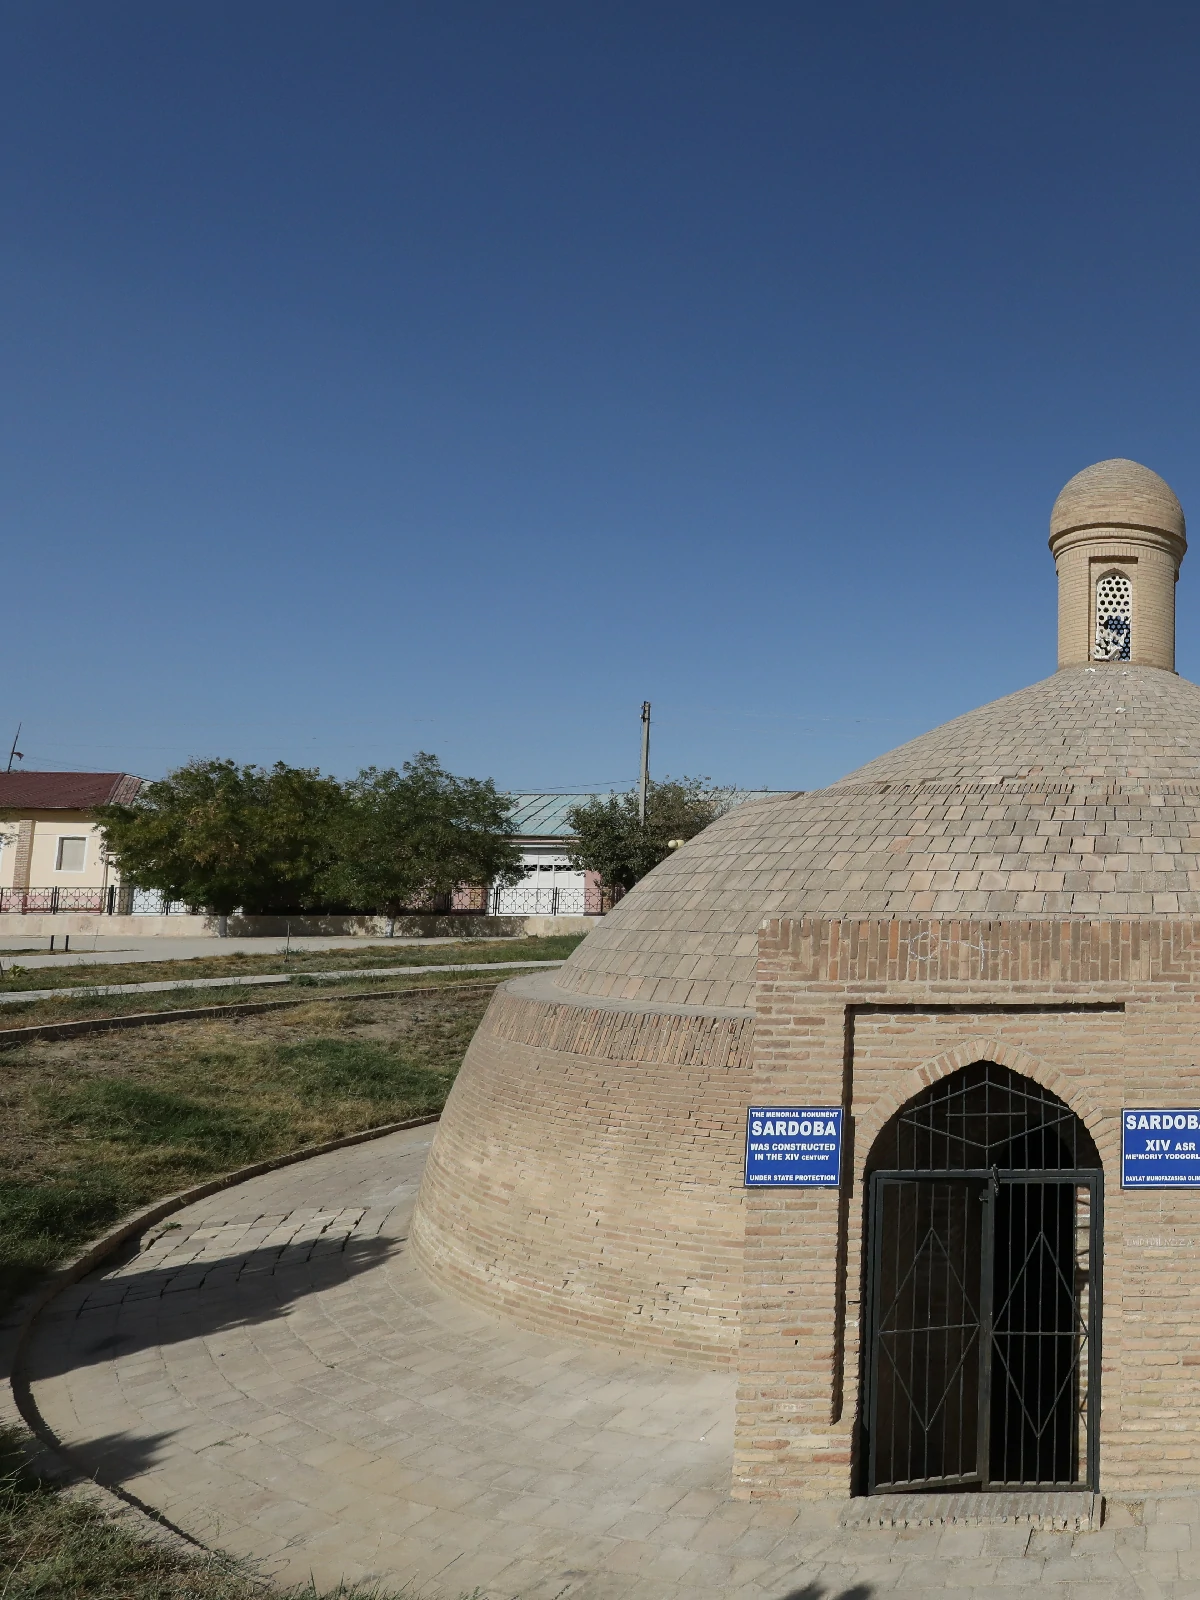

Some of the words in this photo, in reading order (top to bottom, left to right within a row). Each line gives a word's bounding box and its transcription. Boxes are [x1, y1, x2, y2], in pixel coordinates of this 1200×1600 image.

[752, 1121, 836, 1136] SARDOBA
[1145, 1140, 1171, 1151] XIV
[1175, 1143, 1196, 1151] ASR
